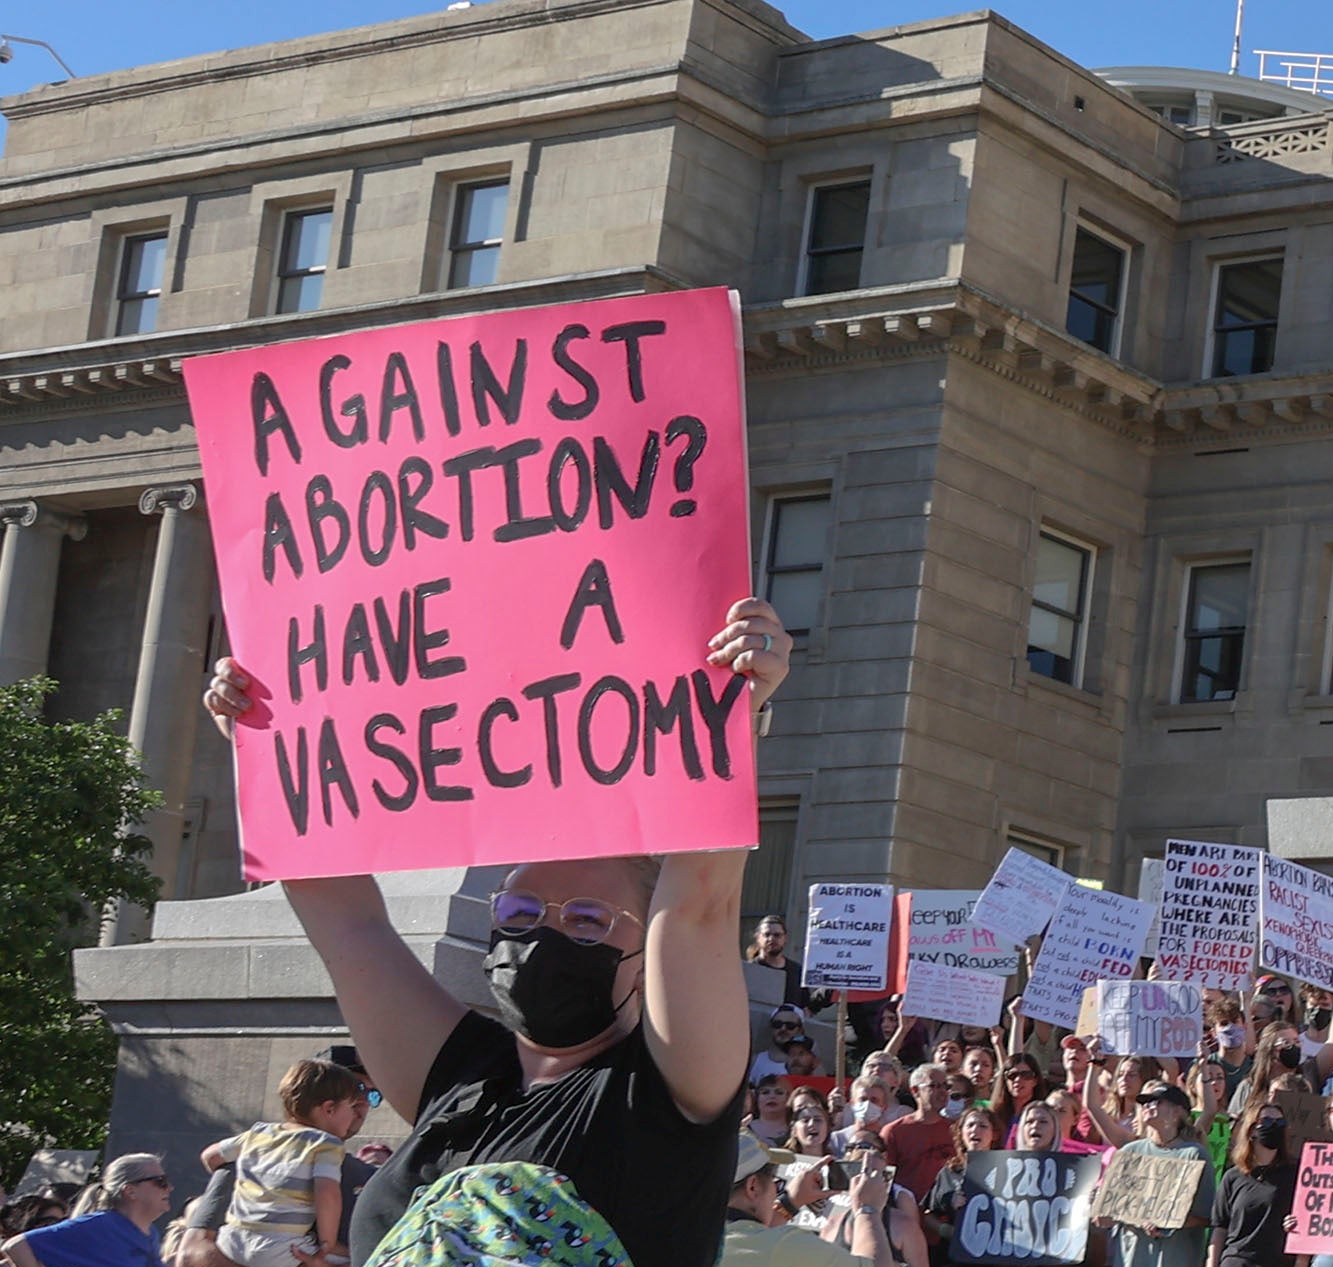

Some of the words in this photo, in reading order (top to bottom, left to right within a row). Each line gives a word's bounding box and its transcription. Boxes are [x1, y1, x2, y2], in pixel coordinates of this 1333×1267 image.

[250, 320, 667, 477] AGAINST
[262, 415, 708, 586] ABORTION?
[287, 577, 467, 704] HAVE
[559, 558, 625, 651] A
[273, 668, 749, 837] VASECTOMY
[1168, 842, 1198, 857] MEN
[1165, 858, 1188, 874] OF
[1191, 861, 1233, 878] 100%
[1233, 866, 1257, 878] OF
[1263, 855, 1309, 889] ABORTION
[819, 885, 882, 899] ABORTION
[1067, 881, 1089, 900] Your
[1174, 875, 1260, 897] UNPLANNED
[843, 903, 856, 914] IS
[1163, 891, 1258, 914] PREGNANCIES
[1268, 881, 1310, 914] RACIST
[810, 919, 887, 933] HEALTHCARE
[1161, 907, 1212, 925] WHERE
[1218, 911, 1251, 927] ARE
[819, 937, 873, 947] HEALTHCARE
[1160, 922, 1187, 937] THE
[1191, 923, 1256, 944] PROPOSALS
[1057, 934, 1081, 947] child
[1084, 937, 1135, 961] BORN
[1159, 937, 1188, 952] FOR
[1193, 940, 1254, 959] FORCED
[847, 963, 874, 973] RIGHT
[1101, 959, 1133, 977] FED
[1160, 953, 1249, 975] VASECTOMIES
[1103, 985, 1139, 1010] KEEP
[1167, 985, 1199, 1016] GOD
[1135, 1014, 1160, 1051] MY
[1160, 1016, 1197, 1054] BOD
[1001, 1157, 1057, 1199] PRO
[1305, 1190, 1326, 1212] OF
